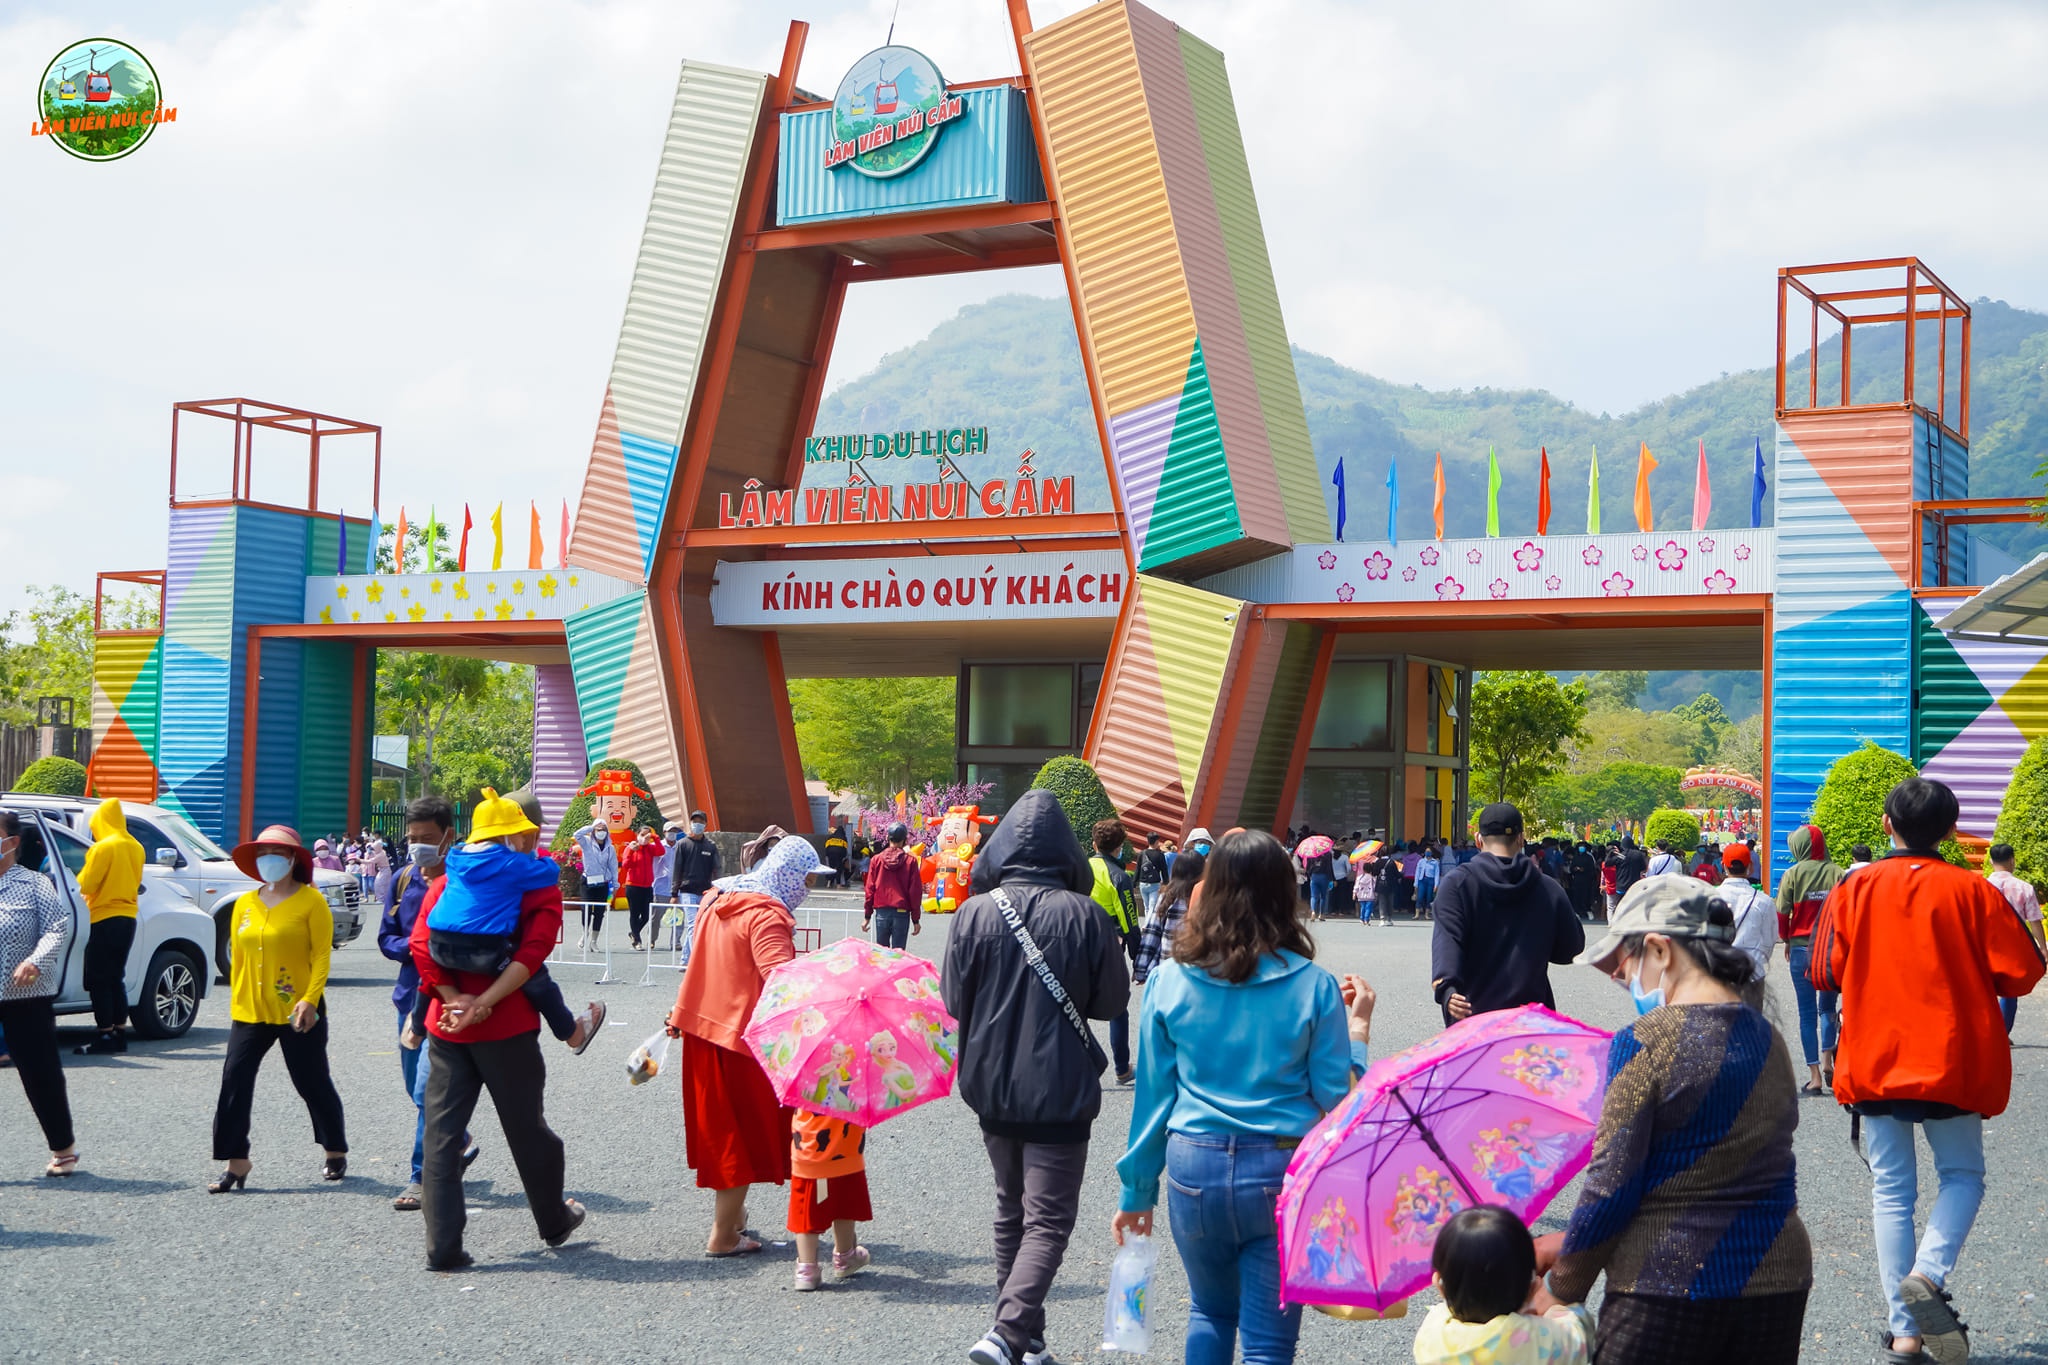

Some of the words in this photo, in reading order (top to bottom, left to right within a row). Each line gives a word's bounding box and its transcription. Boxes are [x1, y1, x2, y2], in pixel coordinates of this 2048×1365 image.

[824, 139, 856, 168] LÂM
[858, 123, 894, 154] VIÊN
[896, 108, 924, 140] NÚI
[926, 91, 963, 127] CẤM
[804, 434, 867, 463] KHU
[872, 431, 915, 459] DU
[919, 427, 988, 465] LỊCH
[719, 477, 795, 528] LÂM
[804, 474, 893, 524] VIÊN
[902, 466, 971, 520] NÚI
[979, 447, 1075, 517] CẤM
[762, 570, 832, 611] KÍNH
[840, 567, 926, 608] CHÀO
[932, 564, 999, 608] QUÝ
[1006, 562, 1121, 604] KHÁCH
[1740, 783, 1753, 792] AN
